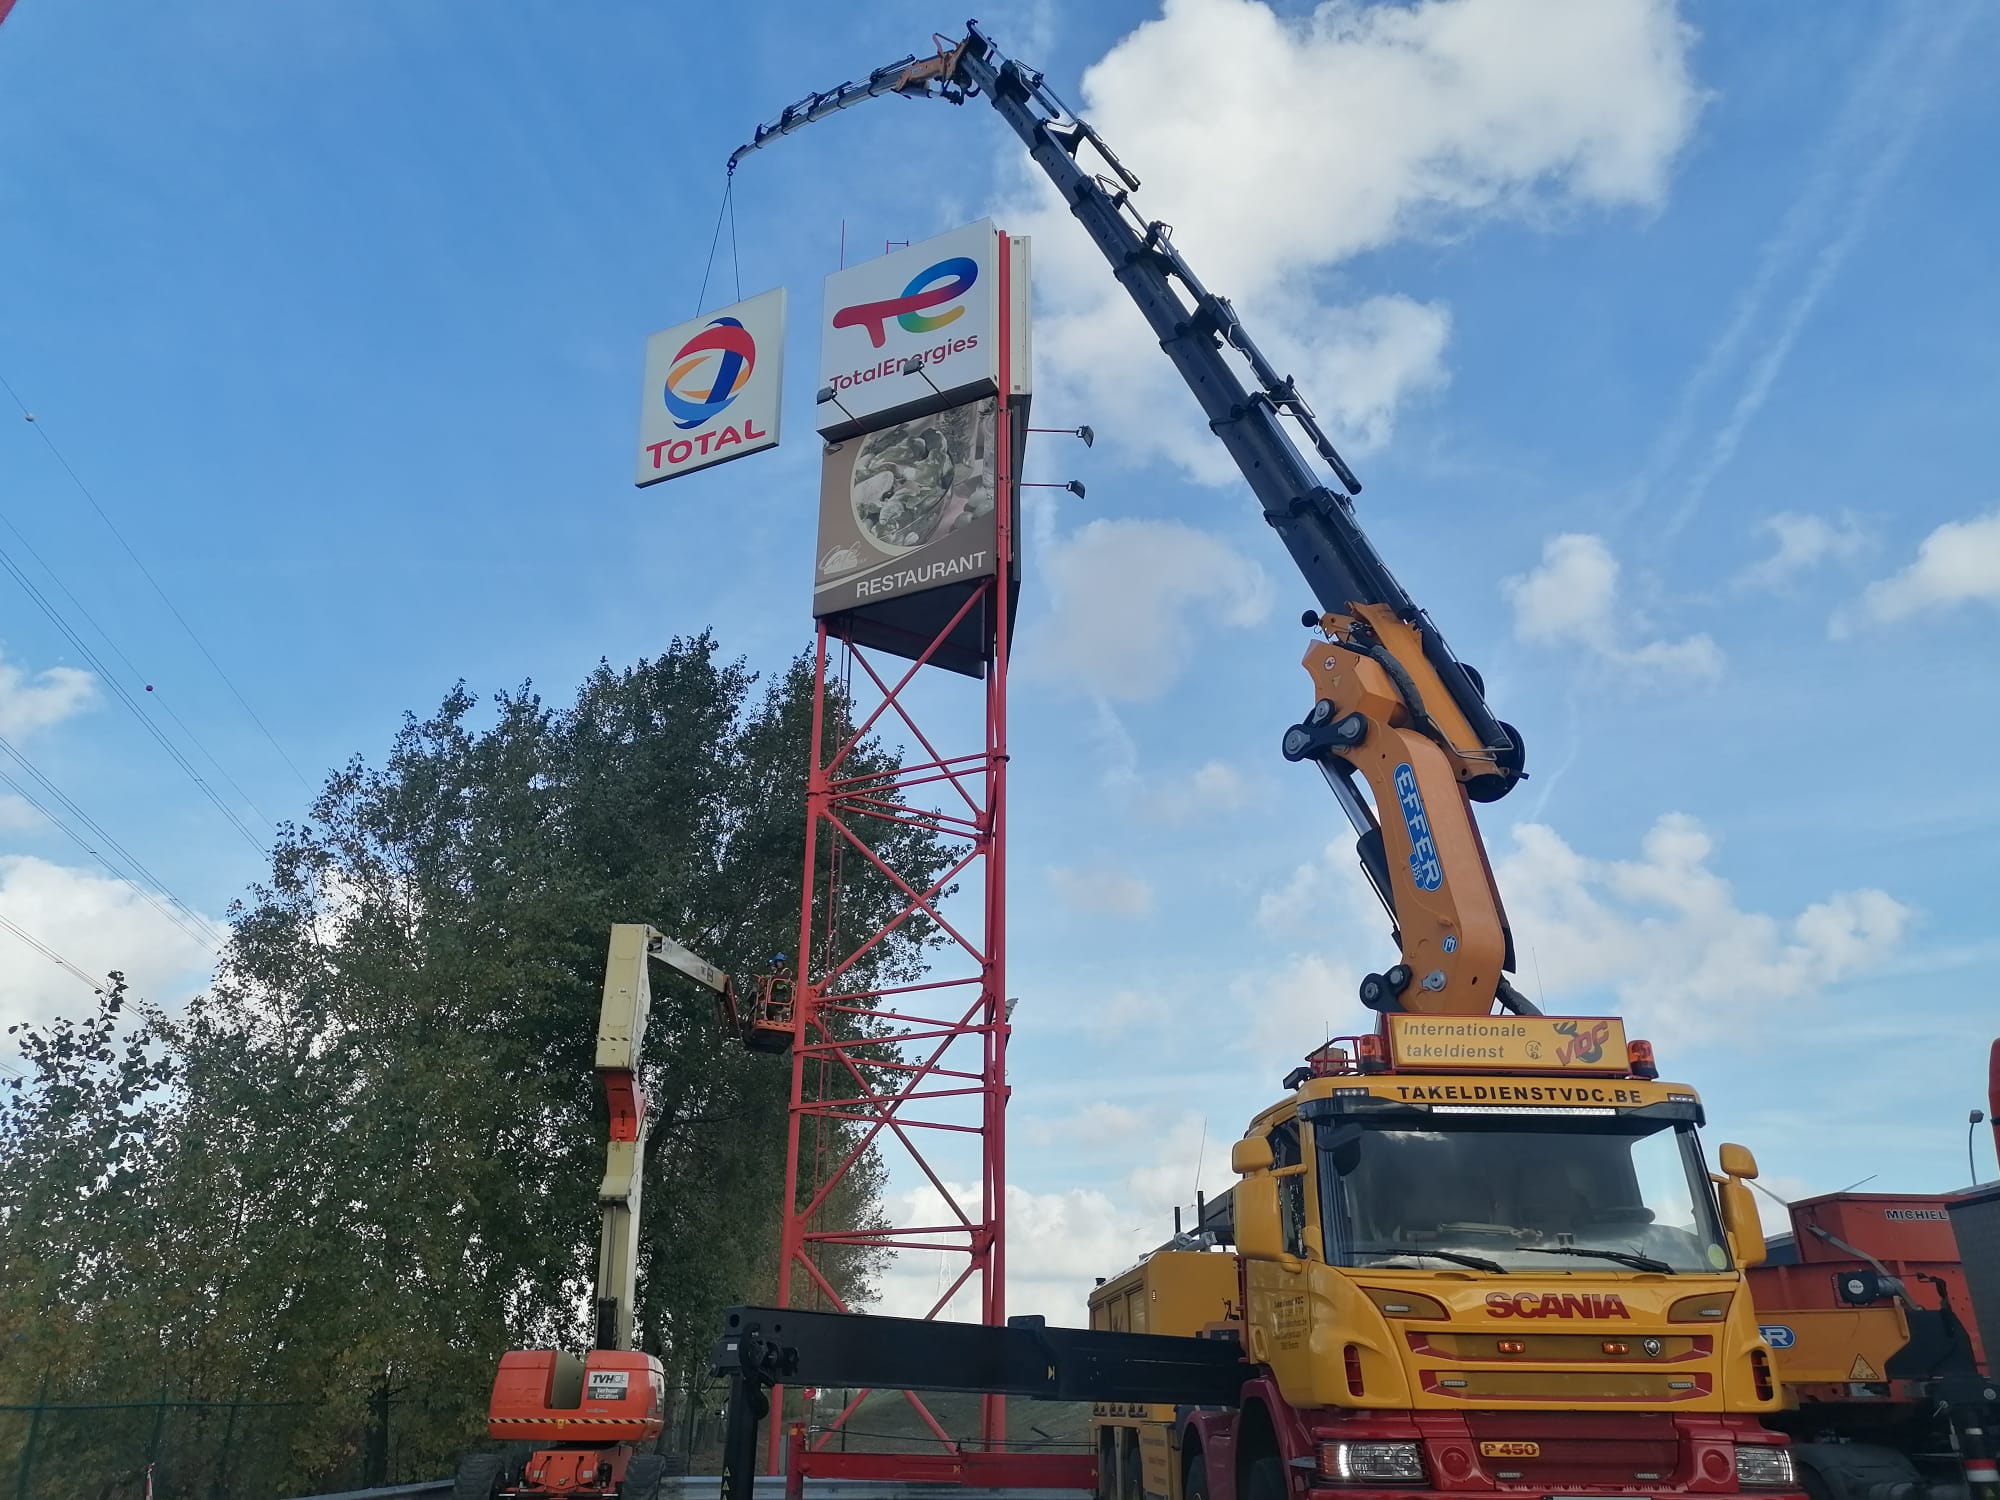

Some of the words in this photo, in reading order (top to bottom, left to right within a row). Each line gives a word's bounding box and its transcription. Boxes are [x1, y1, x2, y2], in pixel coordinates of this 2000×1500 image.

[646, 418, 766, 469] TOTAL
[856, 550, 986, 599] RESTAURANT
[1397, 771, 1440, 885] EFFER
[1404, 1021, 1527, 1038] Internationale
[1406, 1044, 1505, 1058] takeldienst
[1555, 1020, 1610, 1067] VDC
[1397, 1086, 1643, 1104] TAKELDIENSTVDC.BE
[1886, 1209, 1948, 1220] MICHIEL
[1485, 1291, 1631, 1320] SCANIA
[593, 1374, 614, 1384] TVH
[1483, 1443, 1496, 1456] P
[1498, 1443, 1537, 1456] 450
